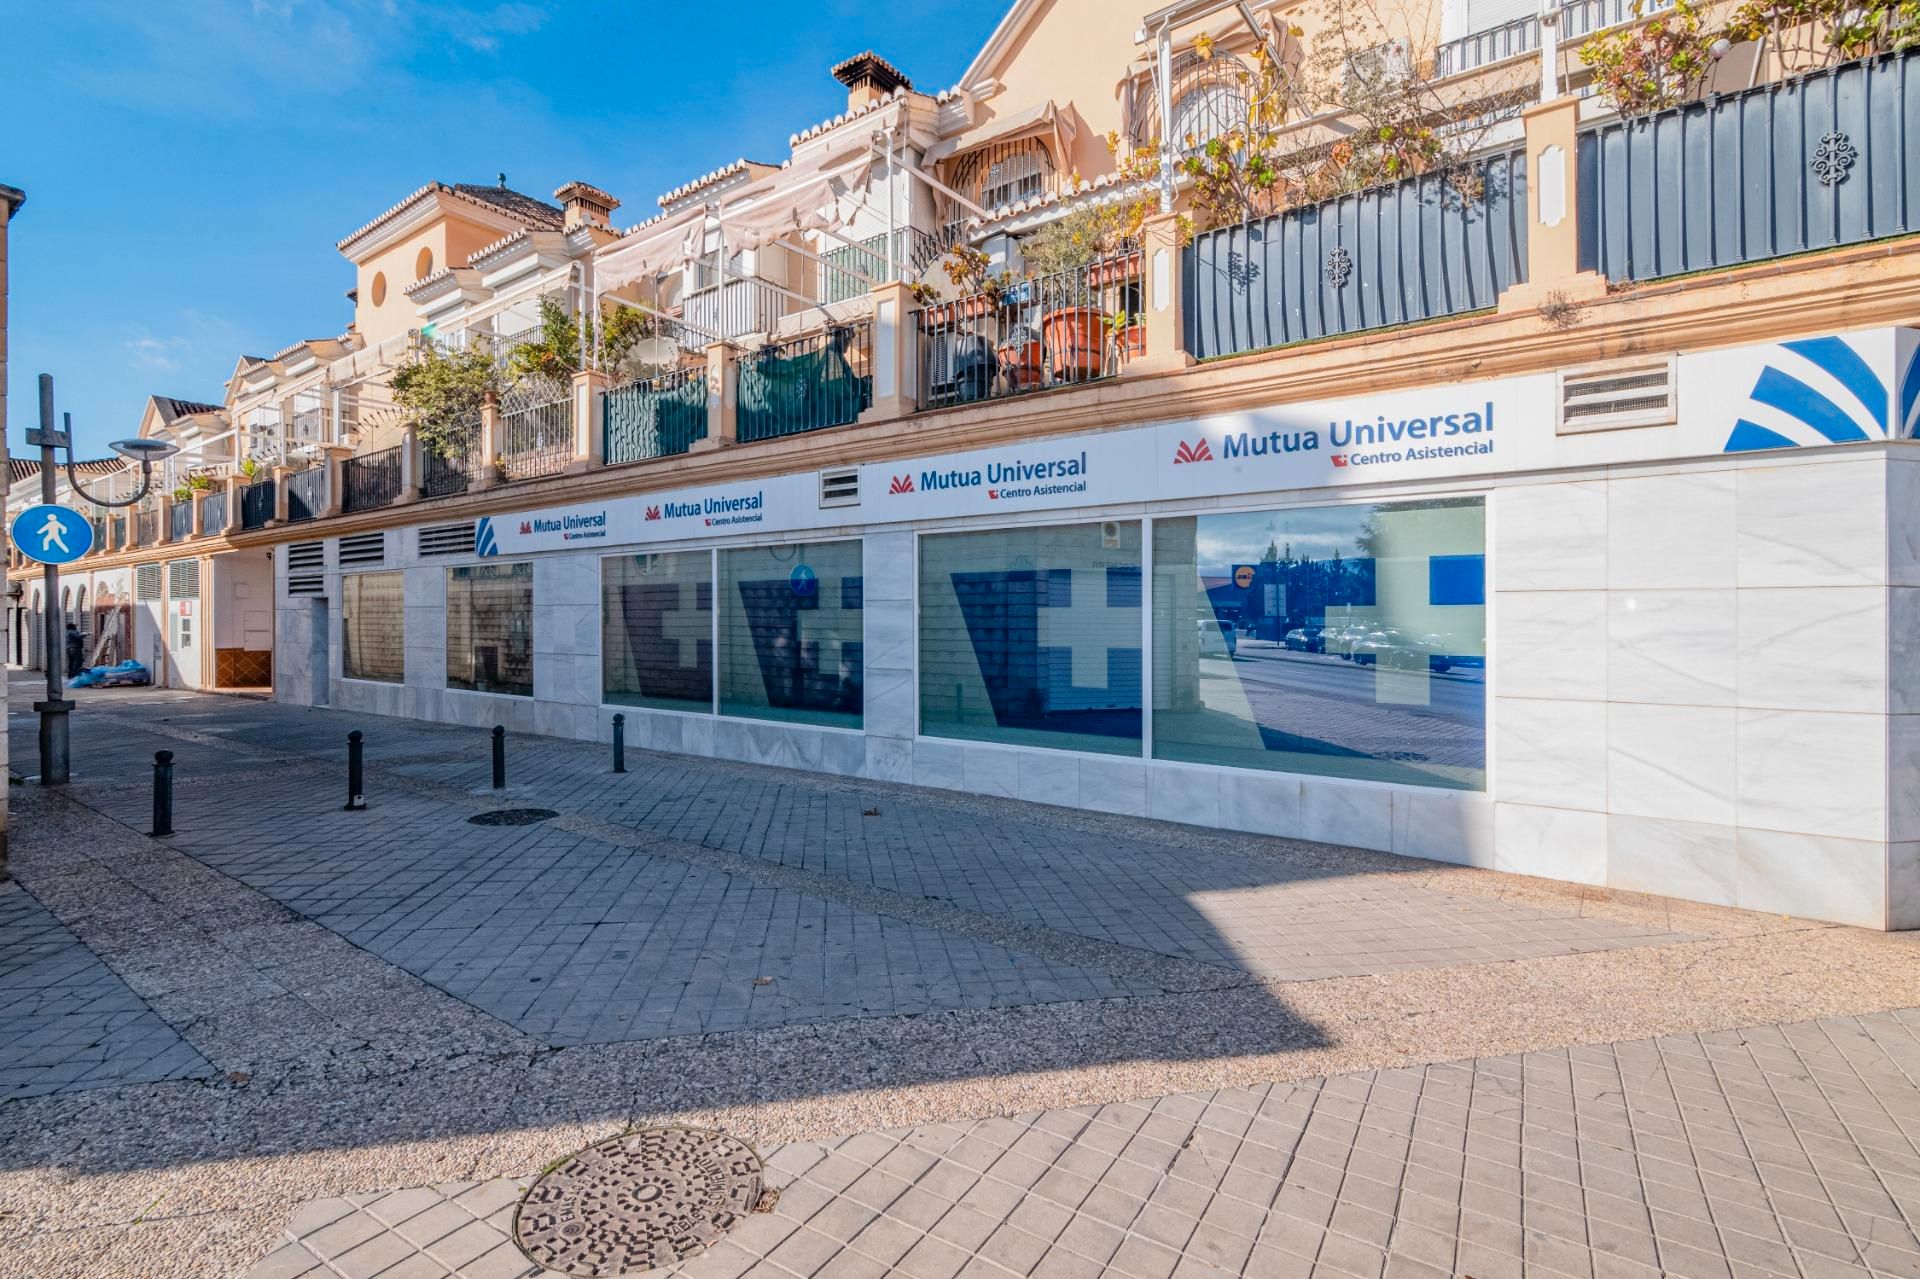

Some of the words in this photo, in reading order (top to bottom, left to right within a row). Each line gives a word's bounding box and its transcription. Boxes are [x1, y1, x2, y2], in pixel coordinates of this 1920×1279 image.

[1223, 430, 1319, 459] Mutua
[1329, 402, 1494, 448] Universal
[1350, 451, 1401, 467] Centro
[1405, 440, 1494, 461] Asistencial
[921, 470, 981, 491] Mutua
[988, 451, 1087, 484] Universal
[1000, 486, 1032, 499] Centro
[1033, 481, 1087, 496] Asistencial
[664, 502, 702, 519] Mutua
[704, 491, 762, 514] Universal
[534, 519, 562, 533] Mutua
[563, 511, 606, 530] Universal
[711, 517, 731, 526] Centro
[731, 512, 762, 524] Asistencial
[568, 532, 583, 540] Centro
